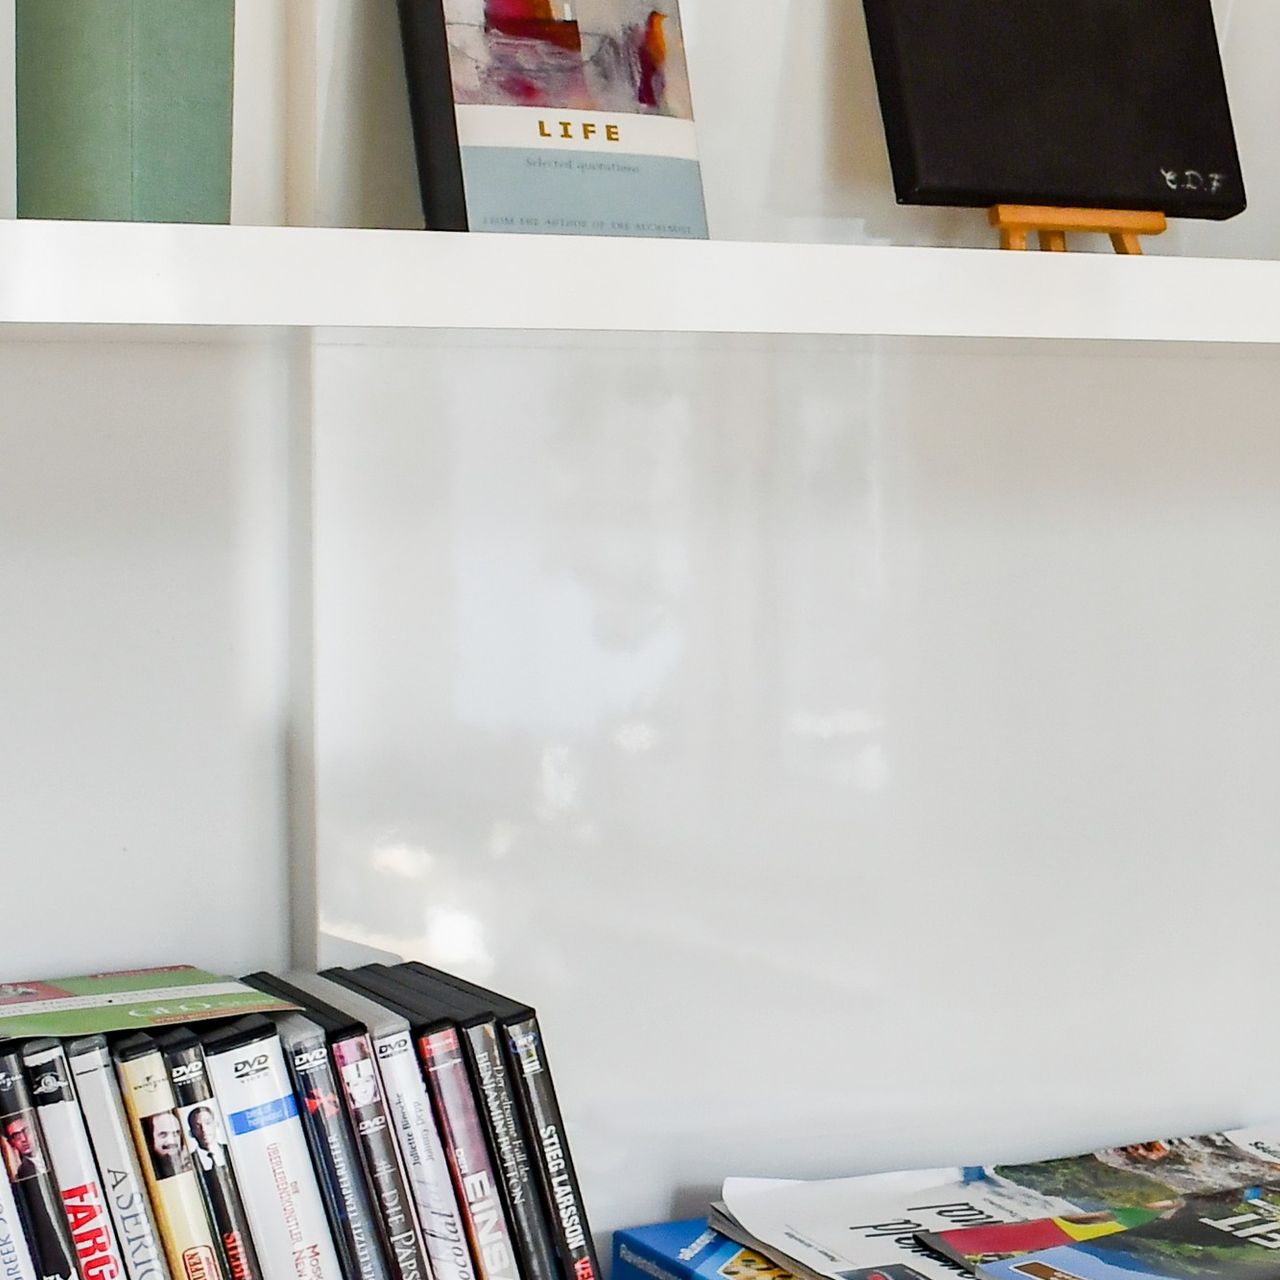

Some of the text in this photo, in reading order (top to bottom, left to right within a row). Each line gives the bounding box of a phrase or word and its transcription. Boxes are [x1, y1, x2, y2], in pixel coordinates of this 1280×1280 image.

[538, 120, 620, 142] LIFE
[294, 1047, 327, 1067] DVD
[379, 1038, 408, 1055] DVD
[172, 1061, 203, 1078] DVD
[234, 1054, 269, 1074] DVD
[476, 1052, 526, 1205] BENJAMIN BUTTON
[403, 1131, 422, 1167] Juliette
[455, 1148, 469, 1174] DER
[107, 1168, 129, 1192] A
[540, 1123, 586, 1252] STIEG LARSSON
[381, 1191, 406, 1225] DIE
